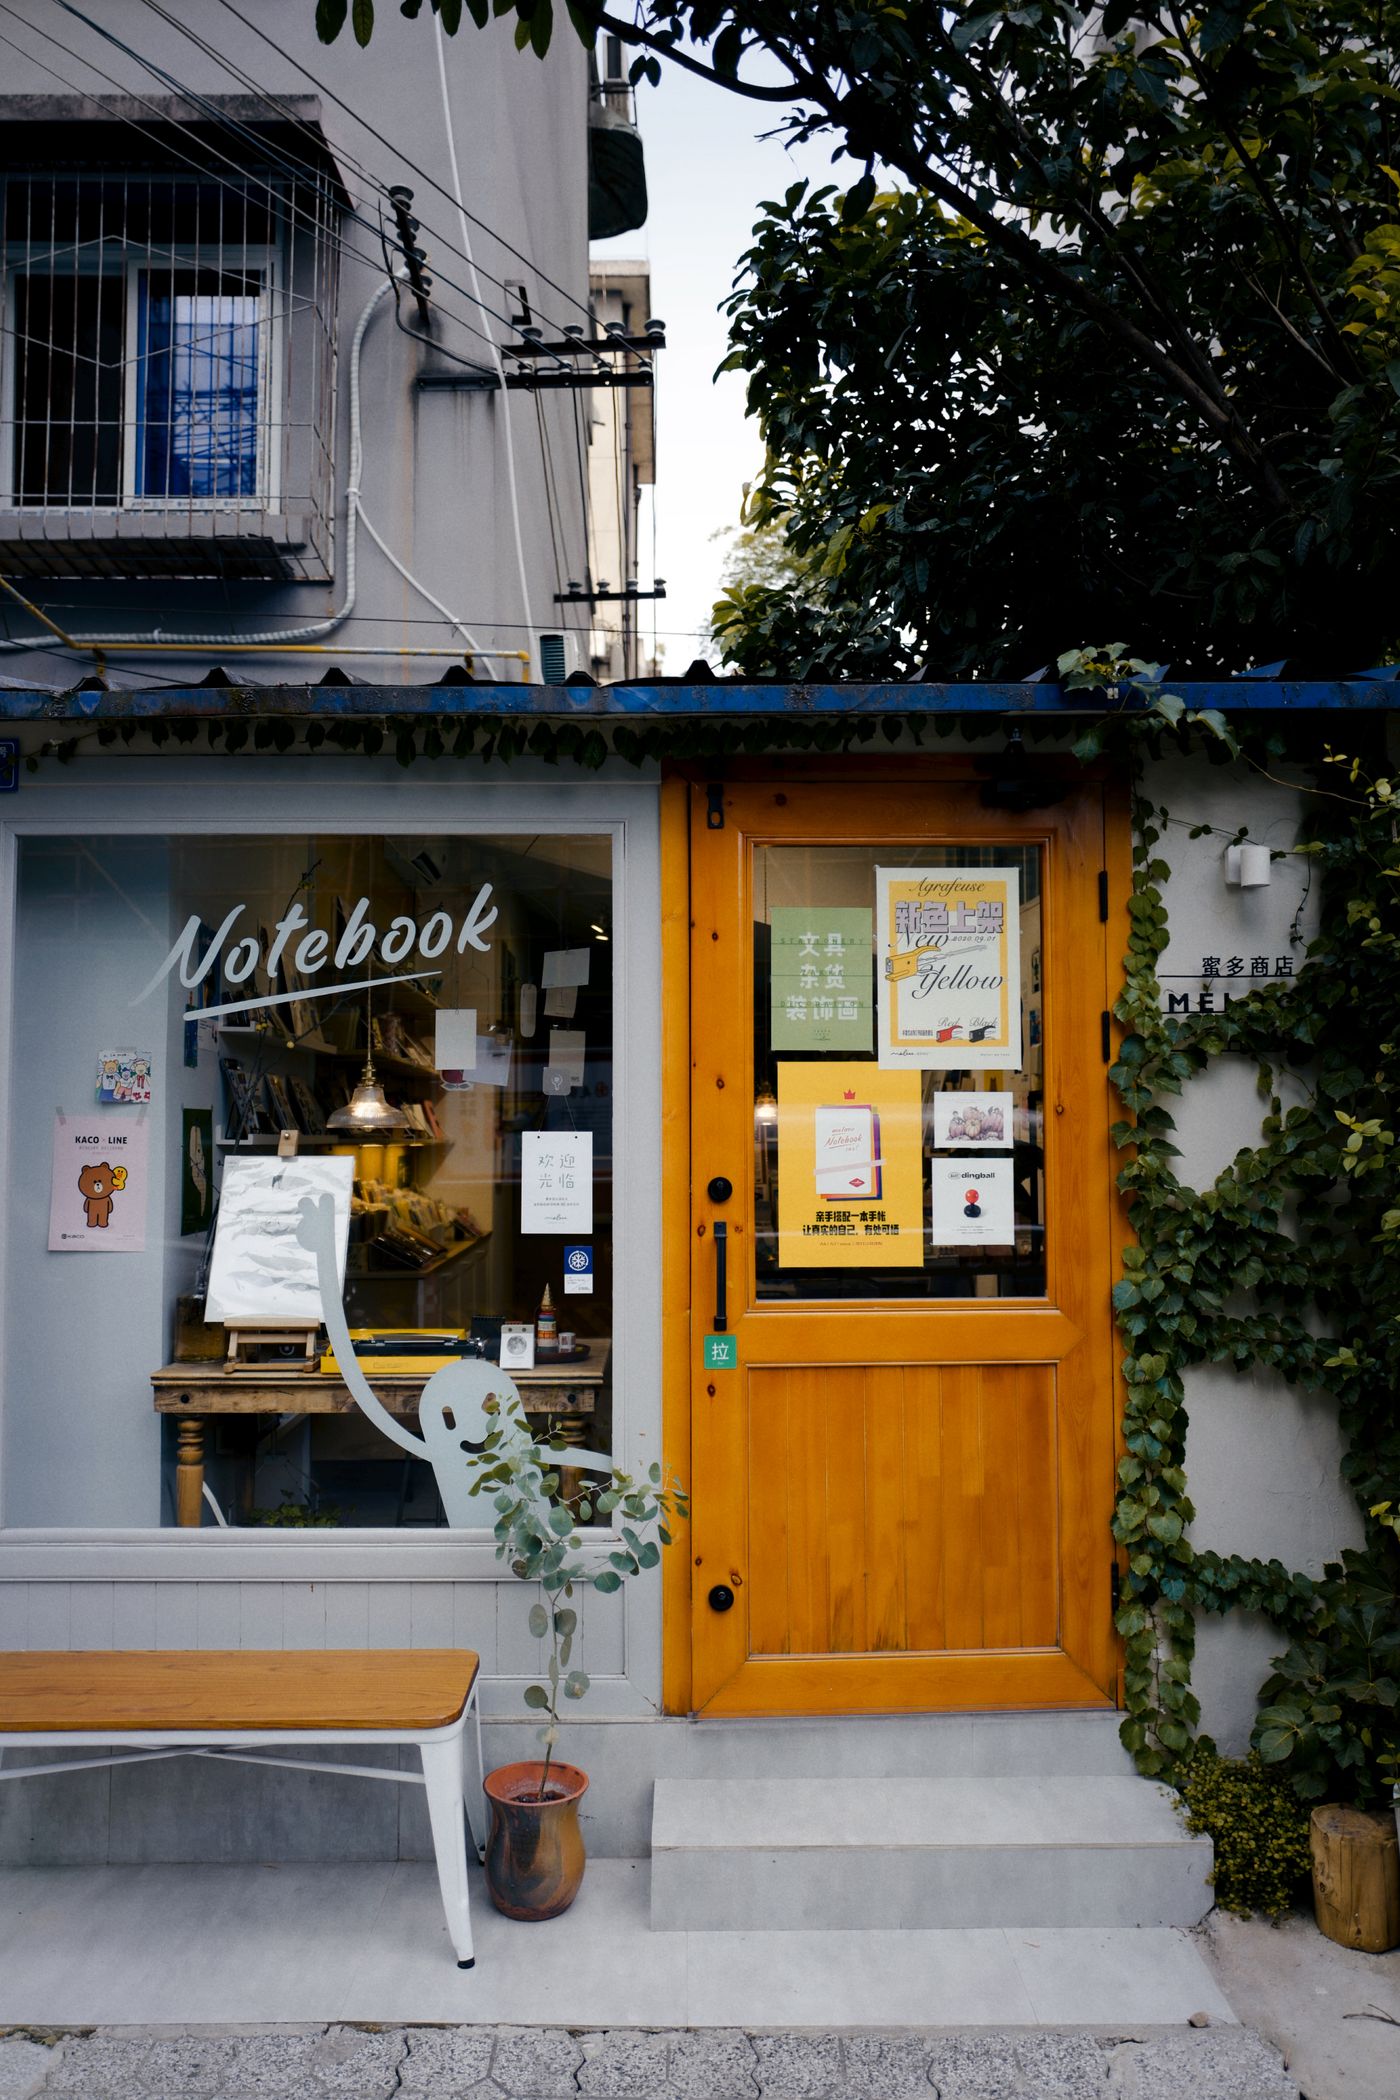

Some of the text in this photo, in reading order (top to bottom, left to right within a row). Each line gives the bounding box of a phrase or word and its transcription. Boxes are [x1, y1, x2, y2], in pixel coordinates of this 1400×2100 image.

[908, 877, 985, 897] Agrafeuse
[895, 901, 1003, 933] 新色上架
[133, 883, 499, 1003] Notebook
[798, 931, 846, 957] 文具
[888, 923, 949, 949] New
[799, 963, 846, 989] 杂货
[1202, 956, 1294, 976] 蜜多商店
[912, 964, 1003, 1000] Yellow
[786, 995, 859, 1021] 装饰画
[75, 1135, 100, 1144] KACO
[108, 1136, 128, 1144] LINE
[538, 1153, 575, 1169] 欢迎
[538, 1172, 575, 1189] 光临
[961, 1171, 996, 1180] dingball
[711, 1342, 729, 1361] 拉
